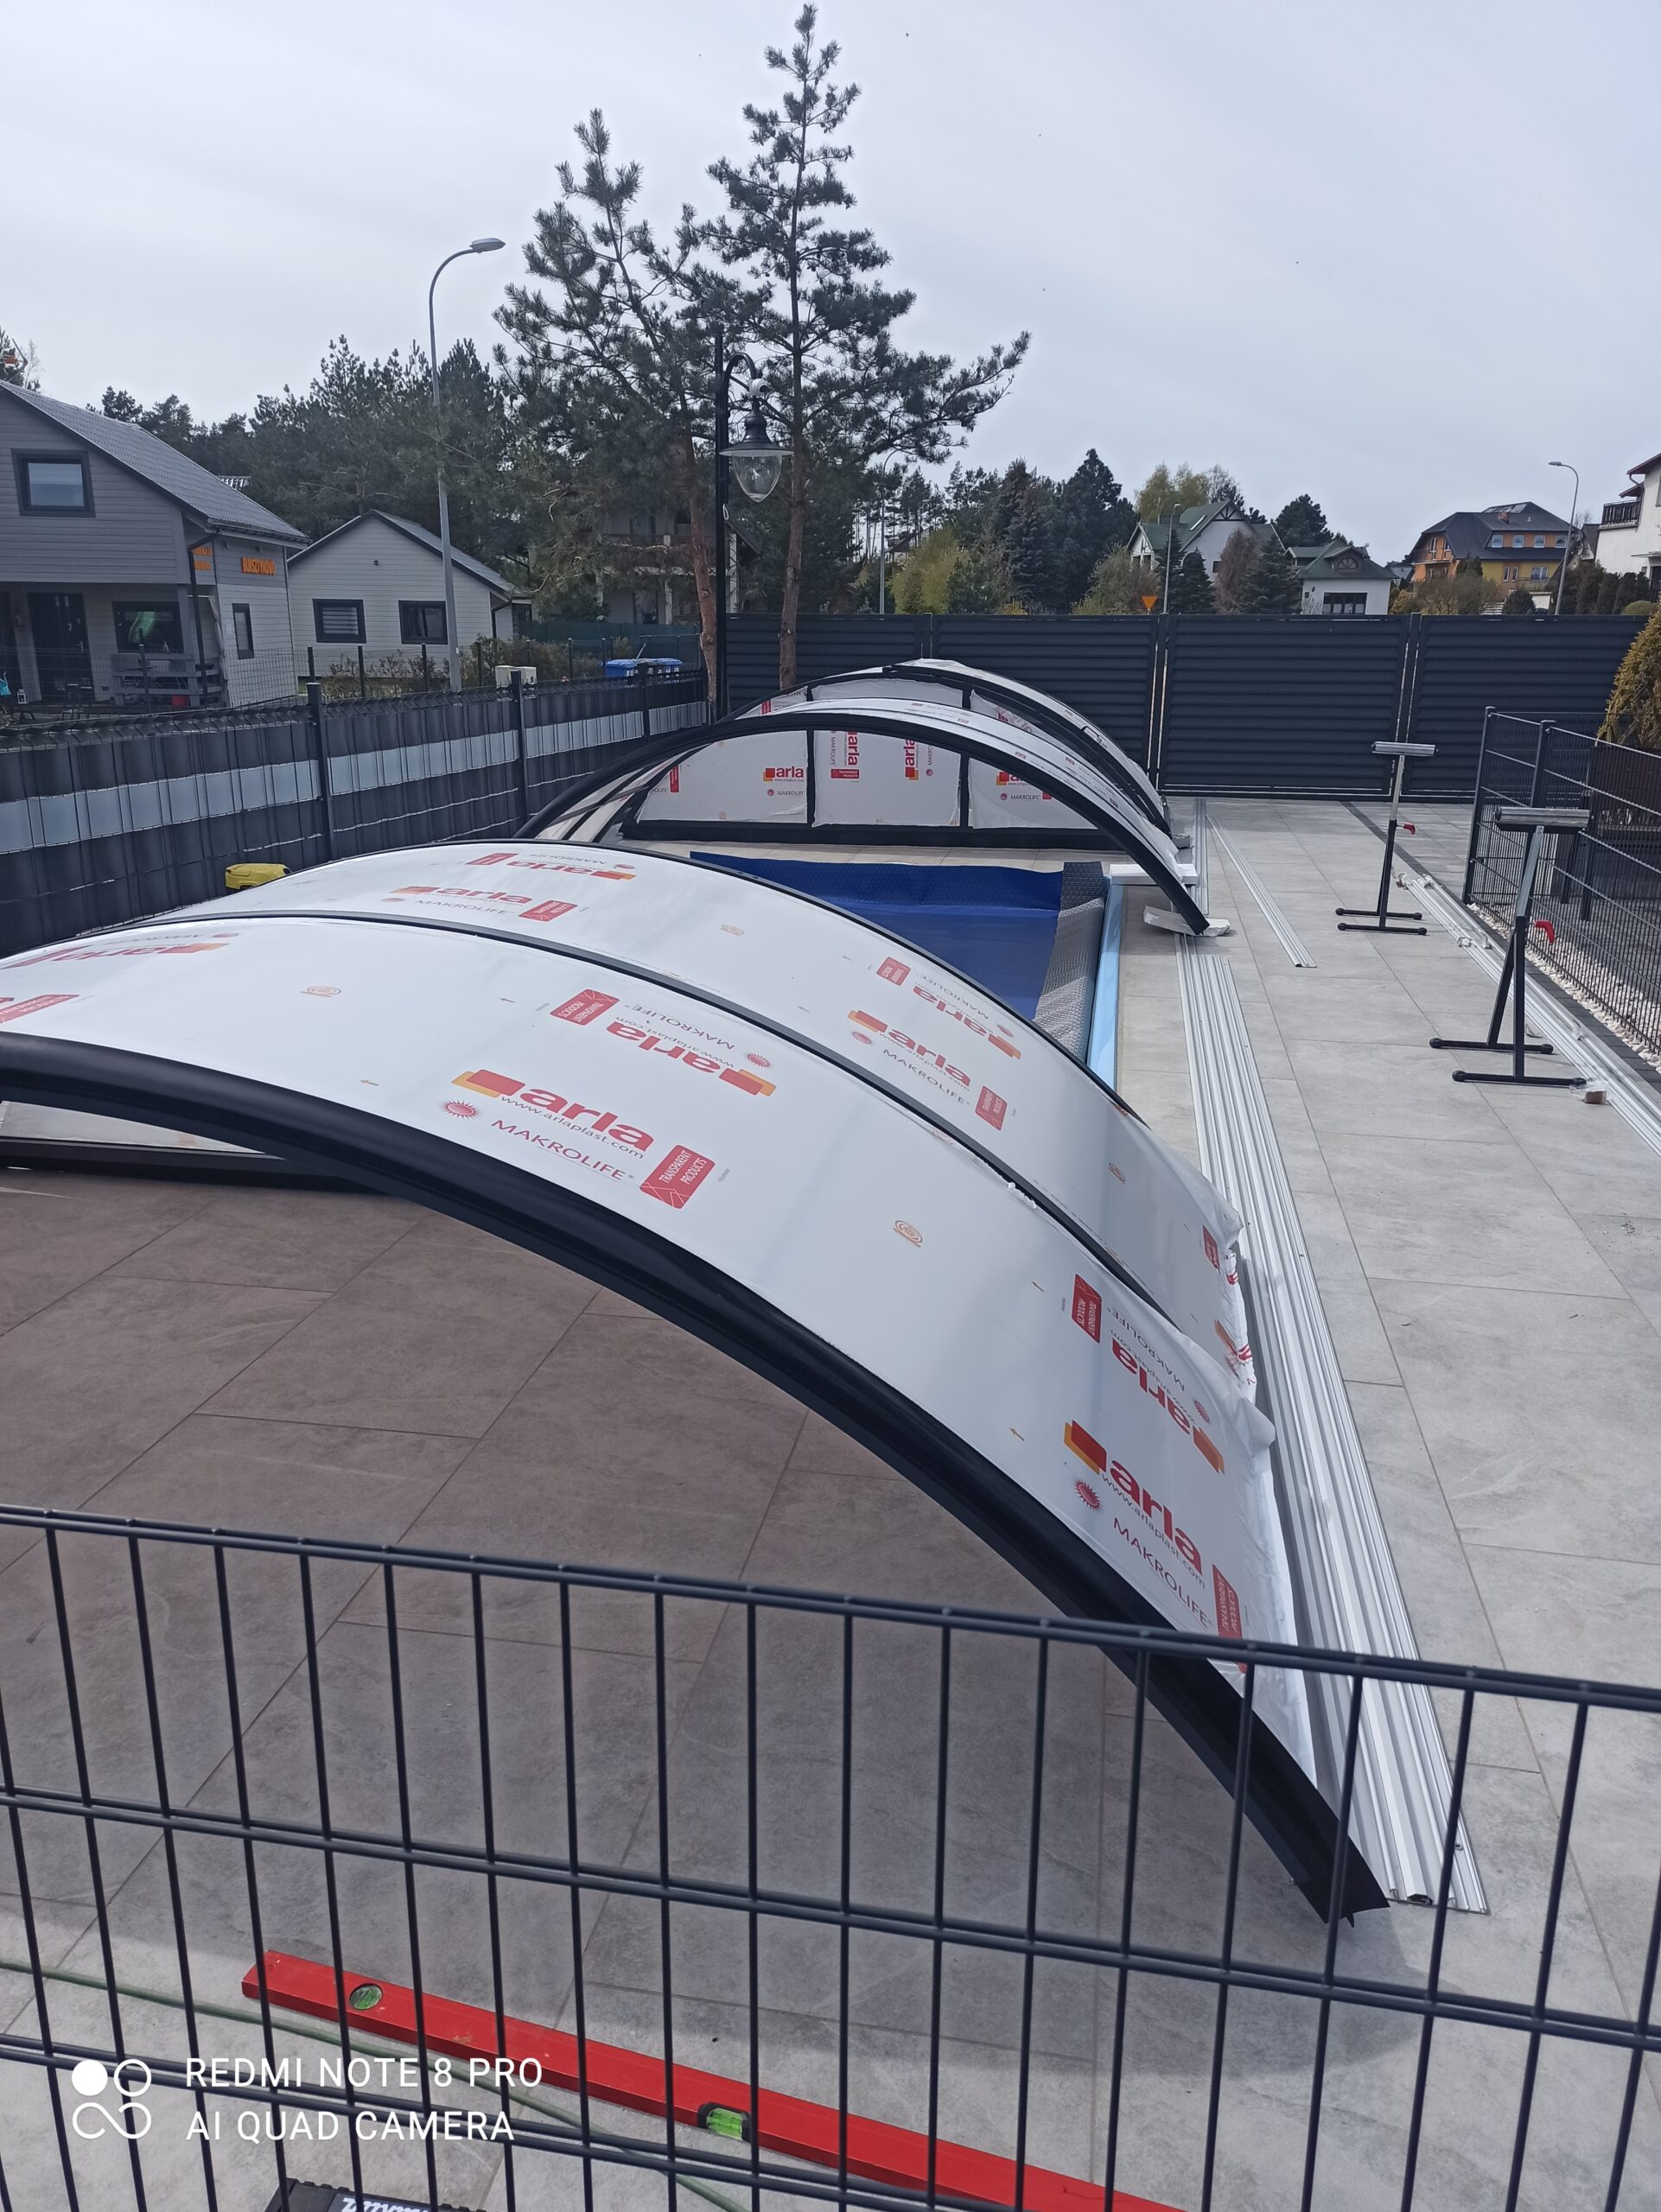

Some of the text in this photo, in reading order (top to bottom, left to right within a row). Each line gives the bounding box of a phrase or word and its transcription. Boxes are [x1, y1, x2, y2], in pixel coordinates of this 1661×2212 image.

[776, 766, 804, 779] arla
[848, 735, 860, 766] arla
[506, 861, 594, 874] arla
[415, 899, 508, 914] MAKROLIFE
[436, 887, 533, 905] arla
[633, 1004, 735, 1050] MAKROLIFE
[913, 985, 987, 1037] arla
[607, 1020, 722, 1073] arla
[616, 1016, 734, 1068] www.arlaplast.com
[888, 1029, 971, 1087] arla
[883, 1049, 966, 1105] MAKROLIFE
[501, 1096, 644, 1160] www.arlaplast.com
[519, 1088, 654, 1152] arla
[491, 1118, 627, 1180] MAKROLIFE
[659, 1149, 692, 1185] TRANSPARENT
[680, 1157, 708, 1185] PRODUCTS
[1111, 1306, 1185, 1392] MAKROLIFE
[1111, 1329, 1196, 1425] www.arlaplast.com
[1112, 1337, 1191, 1435] arla
[1101, 1473, 1206, 1590] www.arlaplast.com
[1110, 1459, 1204, 1577] arla
[1113, 1516, 1208, 1629] MAKROLIFE
[1217, 1571, 1230, 1632] TRANSPARENT
